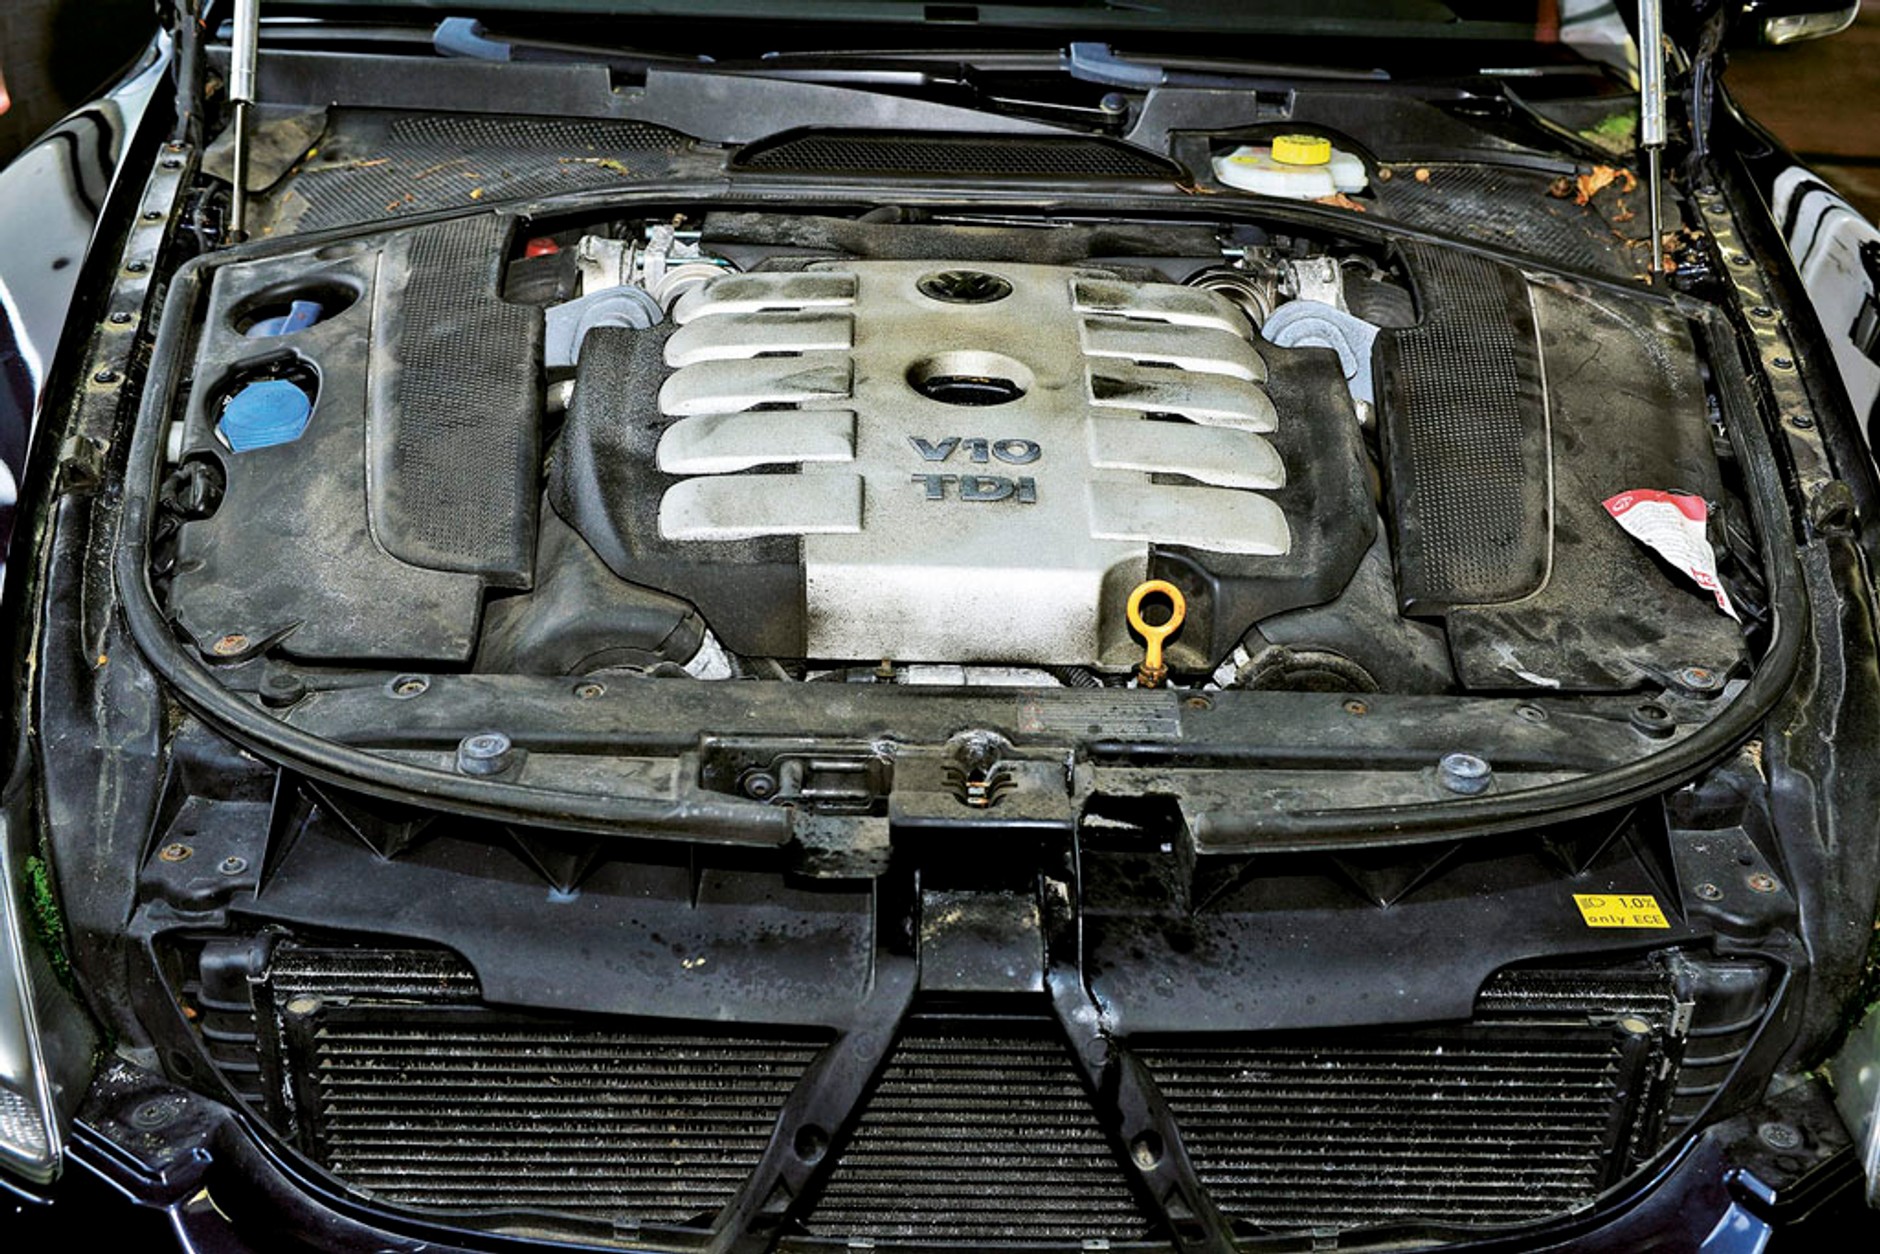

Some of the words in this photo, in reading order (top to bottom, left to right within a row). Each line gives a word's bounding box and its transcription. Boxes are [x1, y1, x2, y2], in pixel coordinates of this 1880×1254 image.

[907, 435, 1042, 465] V10
[911, 473, 1037, 504] TDI
[1619, 897, 1656, 909] 1.0%
[1588, 914, 1625, 924] only
[1633, 914, 1664, 924] ECE
